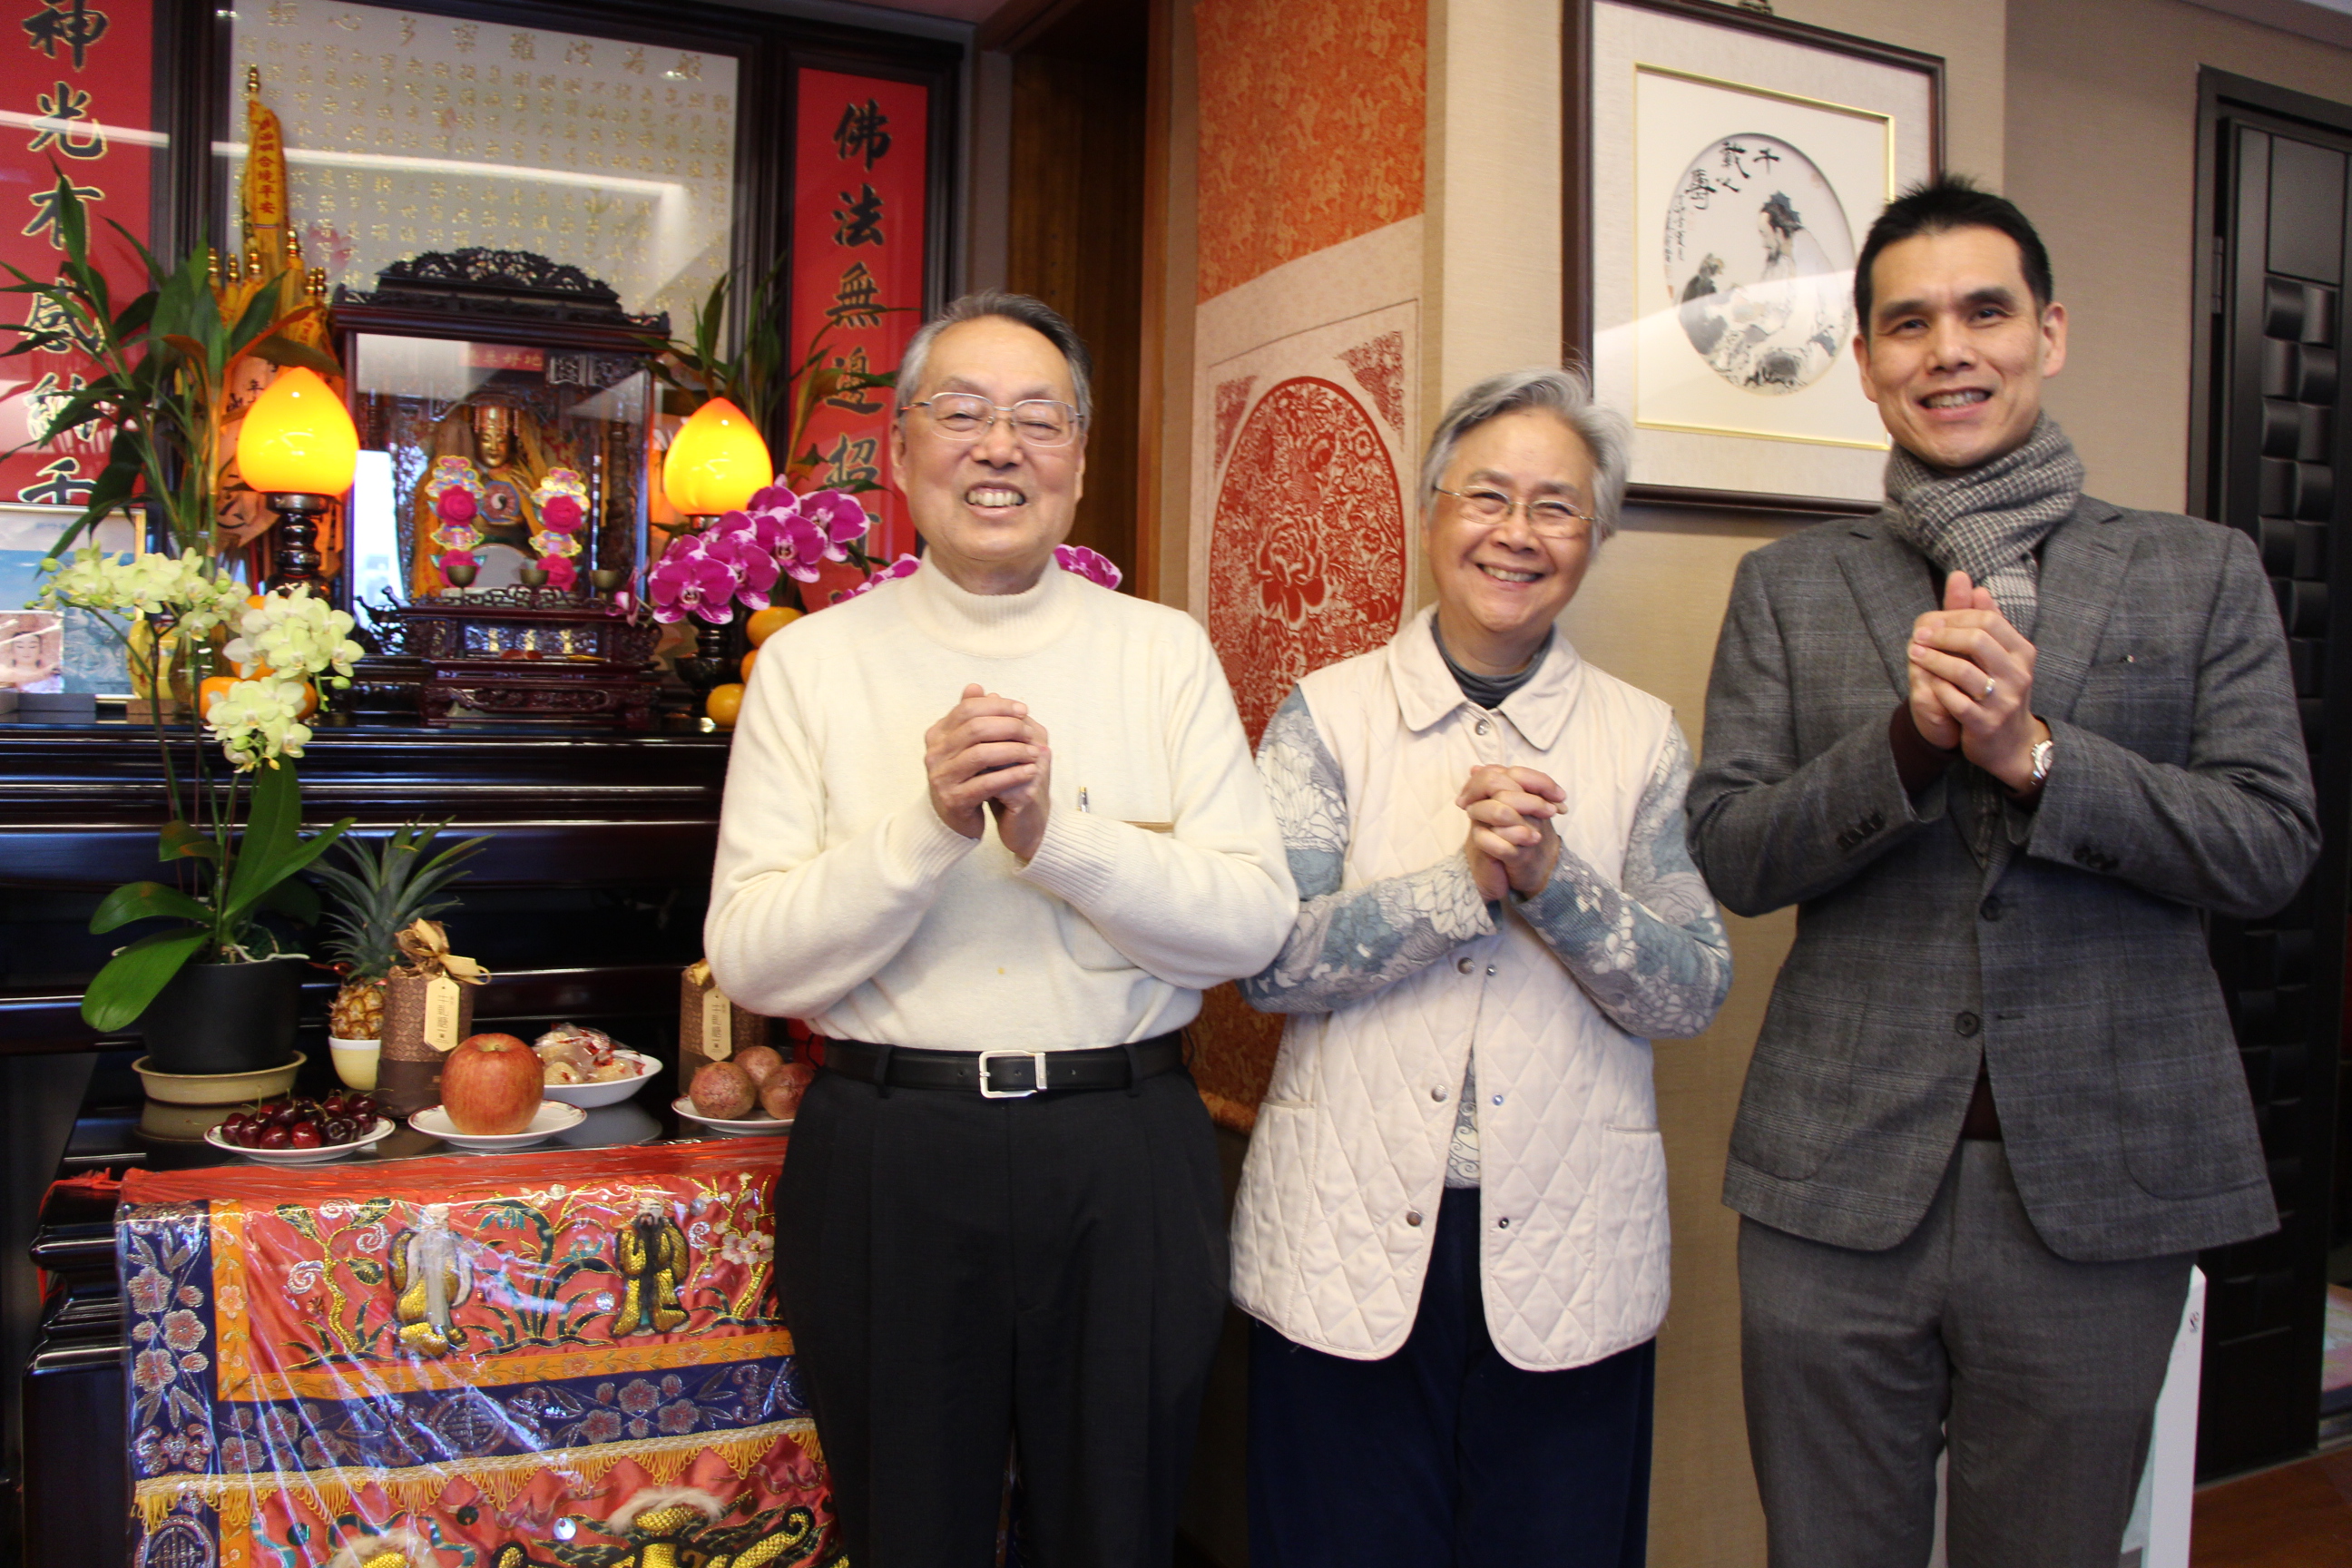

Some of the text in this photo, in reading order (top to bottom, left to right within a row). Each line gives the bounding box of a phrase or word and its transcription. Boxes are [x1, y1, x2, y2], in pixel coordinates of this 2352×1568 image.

[823, 97, 893, 602] 佛法無邊招
